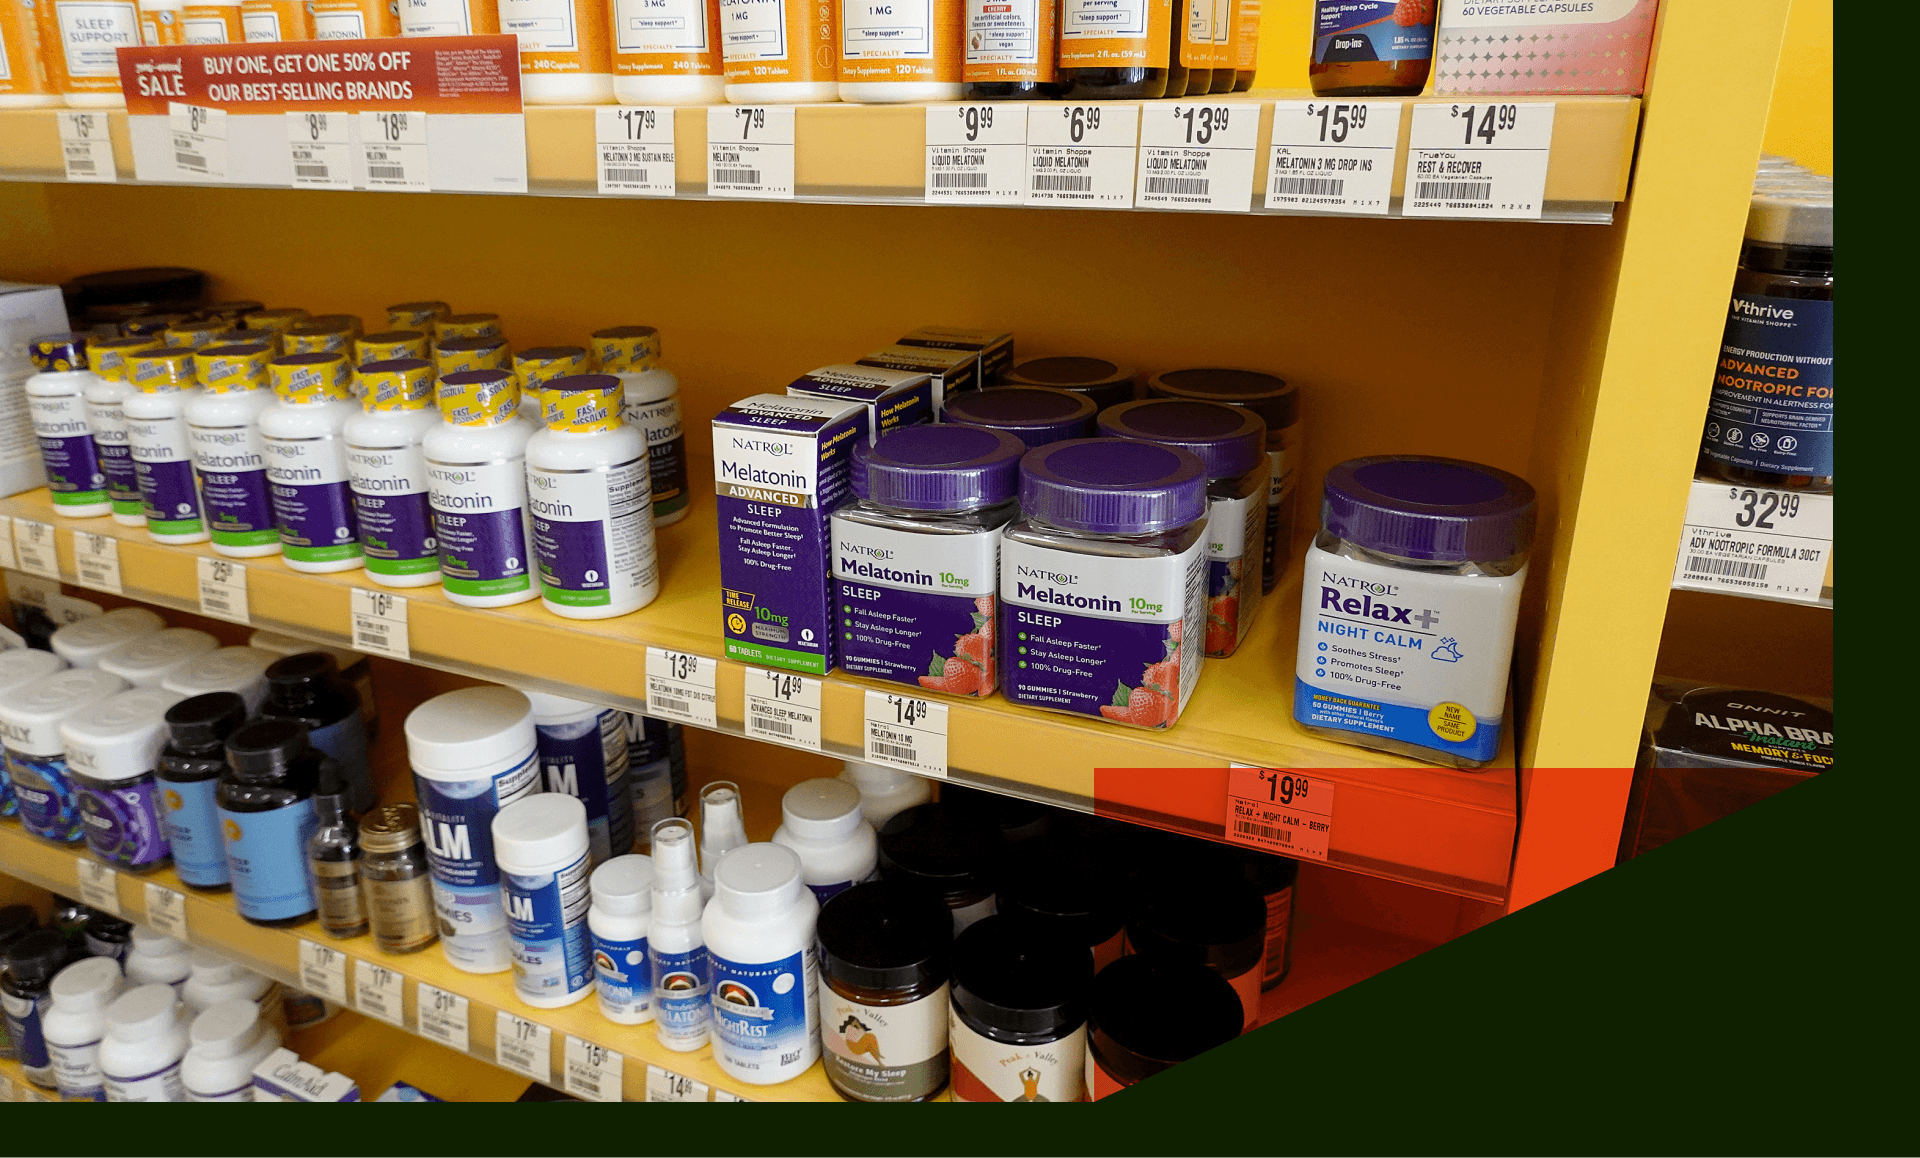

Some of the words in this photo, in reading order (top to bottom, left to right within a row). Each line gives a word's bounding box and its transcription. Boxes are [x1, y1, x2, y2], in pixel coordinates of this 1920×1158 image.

[875, 6, 892, 15] MG
[1320, 5, 1339, 14] Healthy
[1339, 4, 1358, 12] Sleep
[1359, 2, 1379, 11] Cycle
[1462, 7, 1474, 16] 60
[1476, 4, 1538, 15] VEGETABLE
[1538, 2, 1594, 13] CAPSULES
[76, 18, 115, 30] SLEEP
[69, 32, 129, 43] SUPPORT
[204, 56, 238, 75] BUY
[238, 56, 272, 75] ONE,
[273, 54, 303, 74] GET
[305, 53, 341, 73] ONE
[343, 53, 376, 72] 50%
[378, 51, 411, 71] OFF
[534, 60, 550, 69] 240
[551, 62, 580, 71] Capsules
[673, 61, 689, 69] 240
[895, 65, 911, 74] 120
[912, 66, 934, 74] Tablets
[753, 66, 768, 75] 120
[768, 67, 789, 75] Tablets
[137, 75, 187, 97] SALE
[208, 83, 243, 102] OUR
[243, 81, 344, 101] BEST-SELLING
[346, 80, 413, 100] BRANDS
[603, 152, 629, 162] MELATONIN
[642, 153, 662, 162] SUSTAIN
[712, 152, 740, 163] MELATONIN
[963, 147, 987, 155] Shoppe
[1066, 148, 1092, 156] Shoppe
[1147, 149, 1179, 157] Vitamin
[1183, 149, 1211, 158] Shoppe
[1418, 151, 1456, 159] TrueYou
[931, 155, 951, 166] LIQUID
[952, 155, 985, 166] MELATONIN
[1032, 157, 1053, 167] LIQUID
[1054, 157, 1089, 168] MELATONIN
[1146, 158, 1168, 169] LIQUID
[1170, 158, 1207, 171] MELATONIN
[1276, 157, 1316, 170] MELATONIN
[1324, 159, 1336, 170] MG
[1338, 159, 1358, 171] DROP
[1359, 160, 1372, 171] INS
[1417, 161, 1436, 174] REST
[1438, 162, 1445, 173] &
[1447, 161, 1482, 174] RECOVER
[1733, 298, 1794, 320] Vthrive
[1741, 317, 1764, 325] VITAMIN
[1723, 345, 1746, 356] ENERGY
[1746, 350, 1794, 363] PRODUCTION
[1795, 356, 1833, 365] WITHOUT
[1720, 359, 1799, 379] ADVANCED
[812, 376, 876, 389] ADVANCED
[818, 384, 852, 393] SLEEP
[1717, 374, 1804, 397] NOOTROPIC
[577, 404, 596, 418] FAST
[1773, 399, 1818, 409] ALERTNESS
[738, 408, 813, 421] ADVANCED
[749, 416, 788, 426] SLEEP
[721, 460, 807, 489] Melatonin
[729, 485, 799, 505] ADVANCED
[747, 504, 782, 518] SLEEP
[438, 516, 467, 528] SLEEP
[1691, 528, 1732, 538] Vthrive
[1690, 537, 1706, 548] ADV
[1708, 539, 1755, 555] NOOTROPIC
[1756, 544, 1797, 560] FORMULA
[1799, 549, 1821, 562] 30CT
[840, 556, 933, 586] Melatonin
[939, 572, 970, 588] 10mg
[842, 585, 882, 601] SLEEP
[1017, 581, 1122, 612] Melatonin
[1128, 597, 1163, 613] 10mg
[754, 606, 789, 627] 10mg
[1018, 611, 1062, 628] SLEEP
[1030, 634, 1045, 643] Fall
[1046, 638, 1073, 648] Asleep
[1318, 620, 1370, 640] NIGHT
[1374, 631, 1423, 650] CALM
[737, 646, 762, 658] TABLETS
[1030, 648, 1047, 658] Stay
[1048, 652, 1075, 662] Asleep
[1331, 644, 1367, 658] Soothes
[1031, 662, 1051, 672] 100%
[1052, 665, 1093, 678] Drug-Free
[1330, 657, 1373, 673] Promotes
[1330, 671, 1353, 682] 100%
[1355, 675, 1402, 691] Drug-Free
[1027, 685, 1058, 694] GUMMIES
[1062, 689, 1099, 701] Strawberry
[750, 703, 773, 716] ADVANCED
[773, 707, 787, 718] SLEEP
[787, 711, 813, 724] MELATONIN
[1312, 701, 1322, 709] 60
[1322, 703, 1358, 714] GUMMIES
[1363, 709, 1385, 720] Berry
[1443, 712, 1462, 721] NAME
[1445, 706, 1461, 714] NEW
[1726, 702, 1806, 718] ONNIT
[1311, 713, 1343, 724] DIETARY
[1343, 718, 1395, 733] SUPPLEMENT
[1443, 721, 1461, 730] SAME
[1694, 712, 1783, 738] ALPHA
[870, 727, 897, 741] MELATONIN
[1436, 725, 1466, 738] PRODUCT
[1743, 731, 1817, 751] Instant
[1730, 742, 1789, 759] MEMORY
[1791, 751, 1804, 760] &
[1234, 804, 1254, 817] RELAX
[1262, 811, 1281, 823] NIGHT
[1282, 815, 1300, 827] CALM
[1308, 820, 1330, 833] BERRY
[865, 1067, 880, 1079] My
[881, 1068, 907, 1078] Sleep
